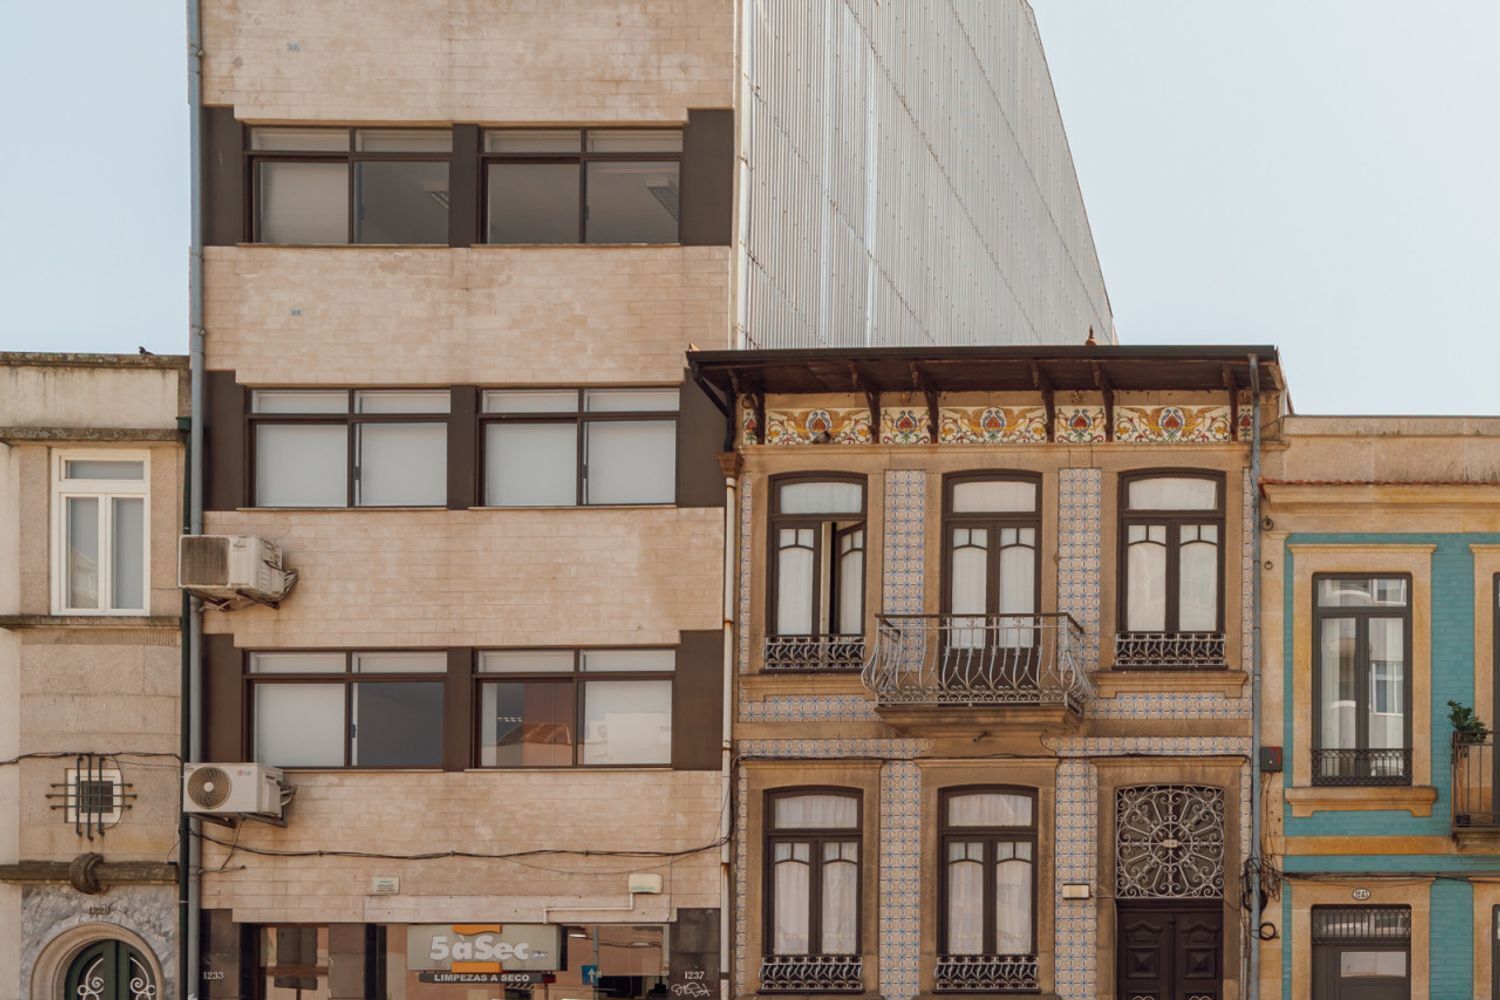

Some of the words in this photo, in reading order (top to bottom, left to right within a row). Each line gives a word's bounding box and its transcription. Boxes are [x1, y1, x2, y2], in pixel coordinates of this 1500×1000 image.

[203, 971, 224, 979] 1233
[434, 974, 487, 982] LIMPEZAS
[490, 974, 498, 982] A
[501, 974, 530, 982] SECO
[684, 970, 705, 980] 1237
